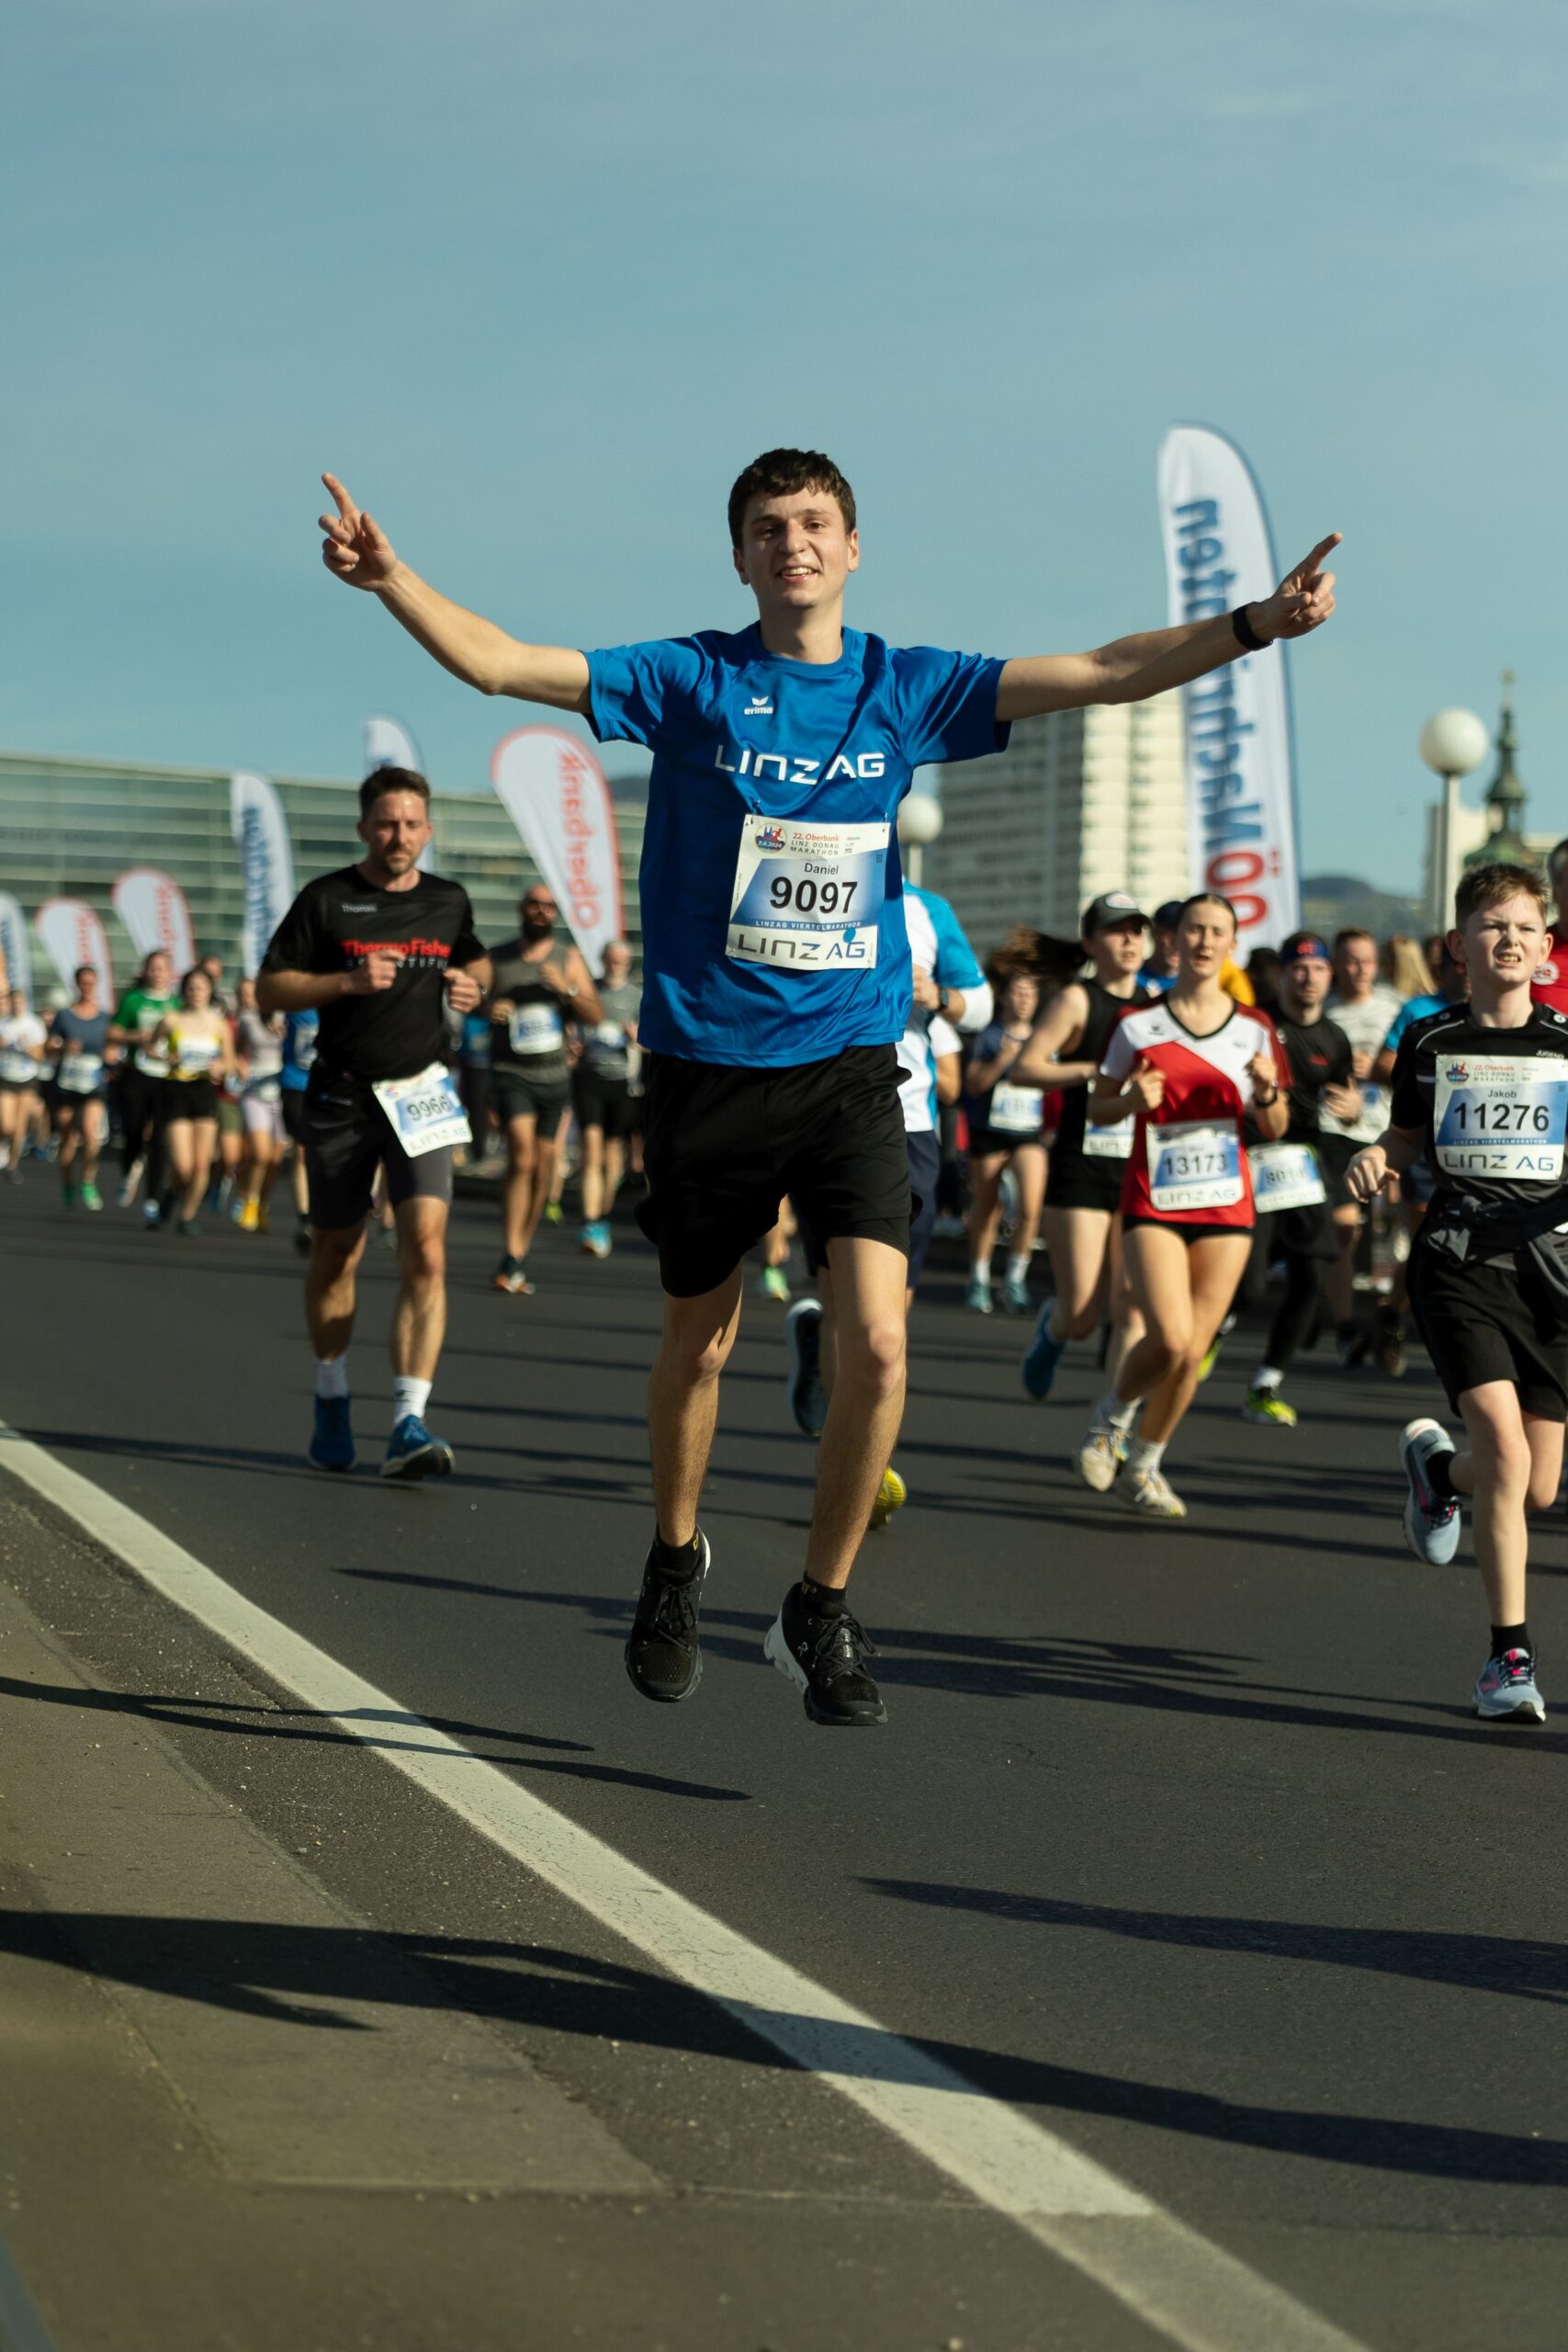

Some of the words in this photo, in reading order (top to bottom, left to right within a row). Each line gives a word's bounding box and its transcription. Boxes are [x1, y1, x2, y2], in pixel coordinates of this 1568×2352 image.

[744, 706, 773, 715] erima
[826, 752, 885, 780] AG
[793, 832, 804, 841] 22.
[805, 833, 840, 842] Oberbank
[790, 846, 839, 855] MARATHON
[804, 863, 840, 875] Daniel
[770, 876, 858, 914] 9097
[791, 922, 861, 931] VIERTELMARATHON
[738, 933, 820, 960] LINZ
[826, 941, 865, 960] AG
[1487, 1090, 1517, 1098] Jakob
[1454, 1102, 1550, 1132] 11276
[1164, 1154, 1228, 1176] 13173
[1443, 1153, 1507, 1170] LINZ
[1516, 1156, 1554, 1170] AG
